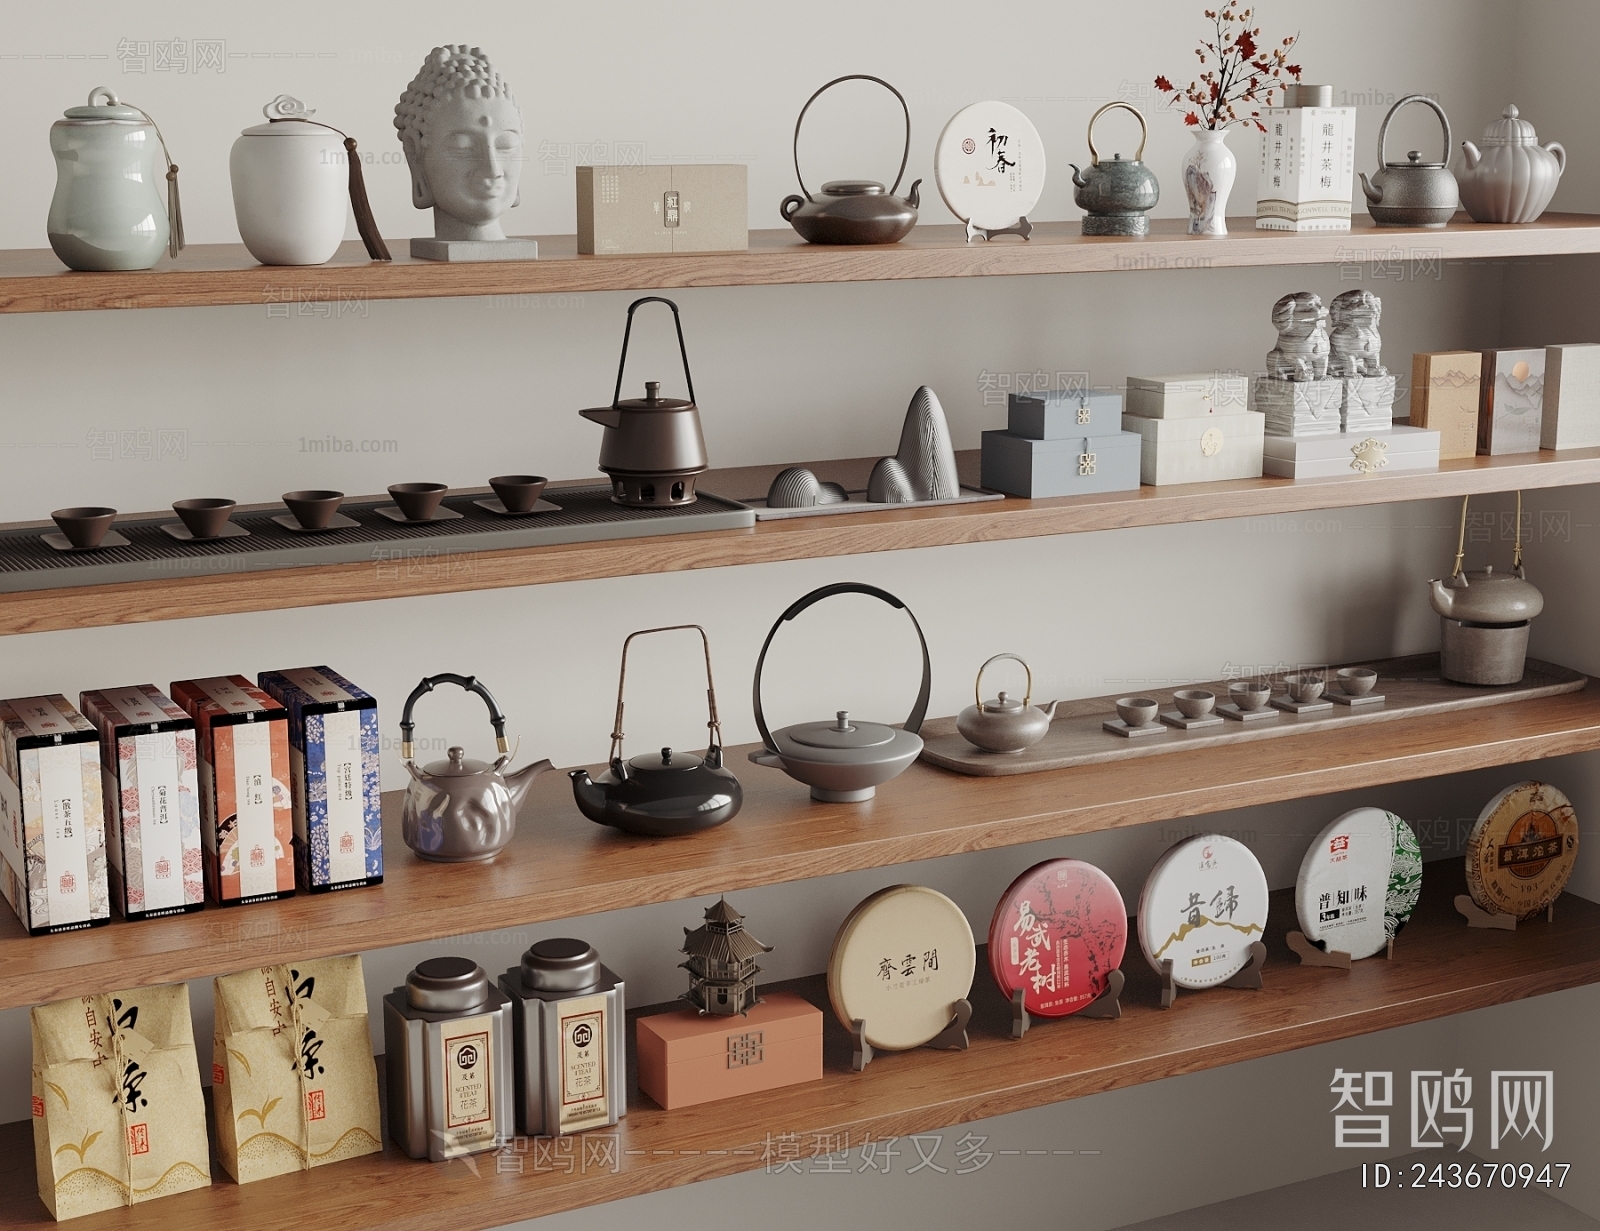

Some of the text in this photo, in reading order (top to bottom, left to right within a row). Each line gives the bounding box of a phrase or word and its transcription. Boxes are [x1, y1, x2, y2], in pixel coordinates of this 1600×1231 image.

[985, 127, 1016, 173] 初春
[1320, 123, 1334, 188] 龍井茶梅
[1503, 841, 1558, 862] 普洱沱茶
[570, 1061, 596, 1070] SCENTED
[575, 1076, 591, 1087] 花茶
[455, 1083, 482, 1093] SCENTED
[460, 1098, 477, 1110] 花茶
